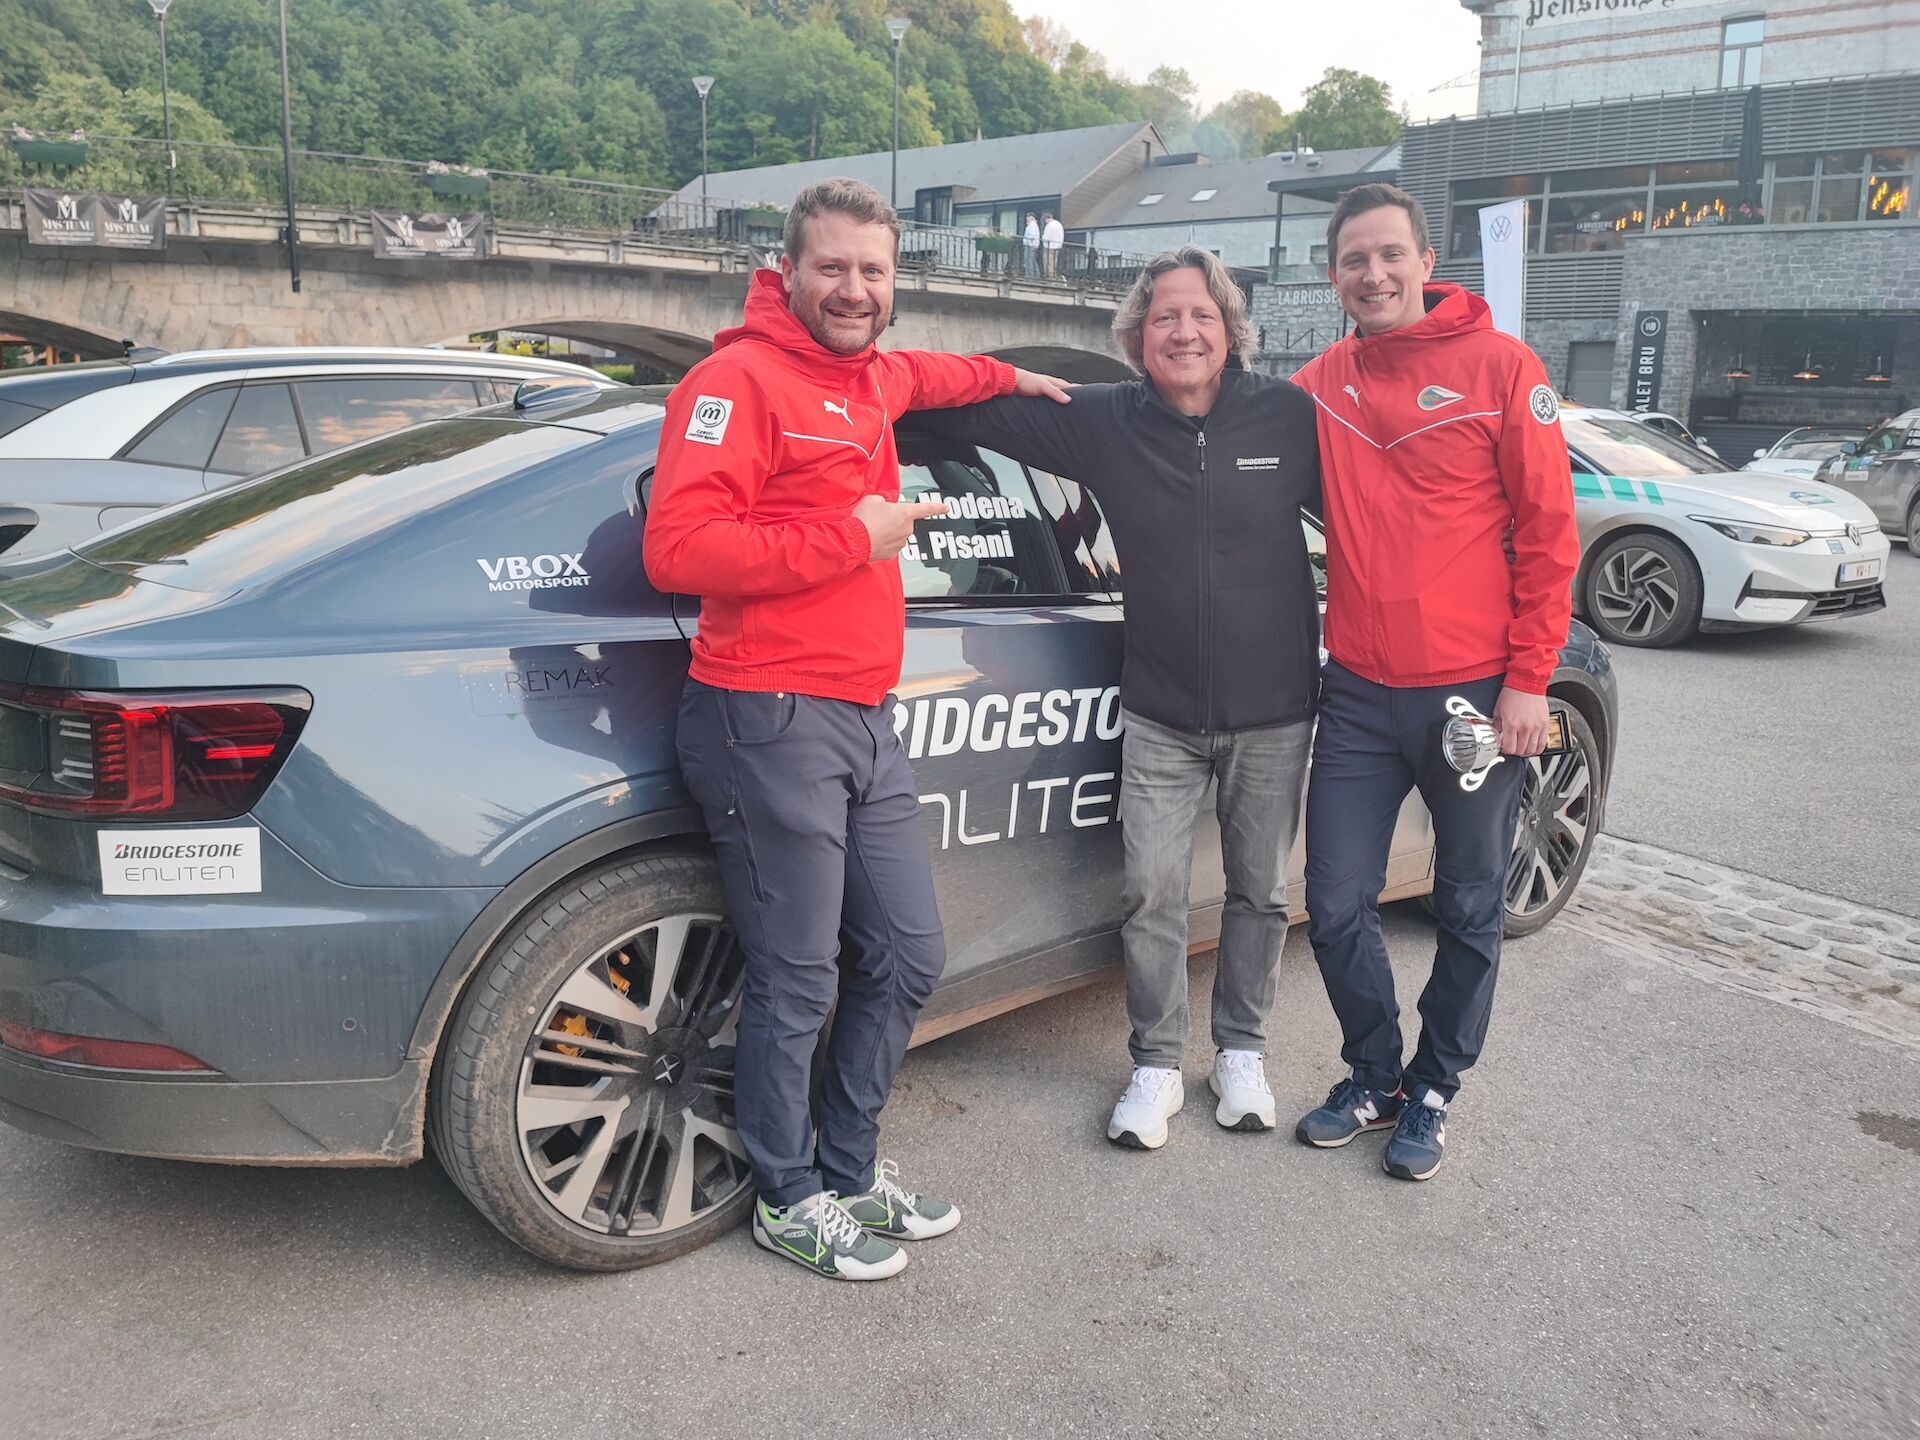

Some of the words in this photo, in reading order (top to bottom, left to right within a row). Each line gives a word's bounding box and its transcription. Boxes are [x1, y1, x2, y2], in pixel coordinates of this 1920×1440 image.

[1278, 291, 1290, 305] LA
[1292, 288, 1338, 305] BRUSSE
[1638, 346, 1656, 375] BRU
[1634, 379, 1652, 413] ALET
[917, 492, 1027, 520] Modena
[928, 530, 1015, 560] Pisani
[476, 553, 588, 581] VBOX
[488, 576, 592, 592] MOTORSPORT
[505, 666, 615, 693] REMAK
[892, 686, 1125, 759] IDGESTO
[917, 772, 1122, 850] NLITE
[114, 843, 244, 859] BRIDGESTONE
[125, 865, 235, 882] ENLITEN
